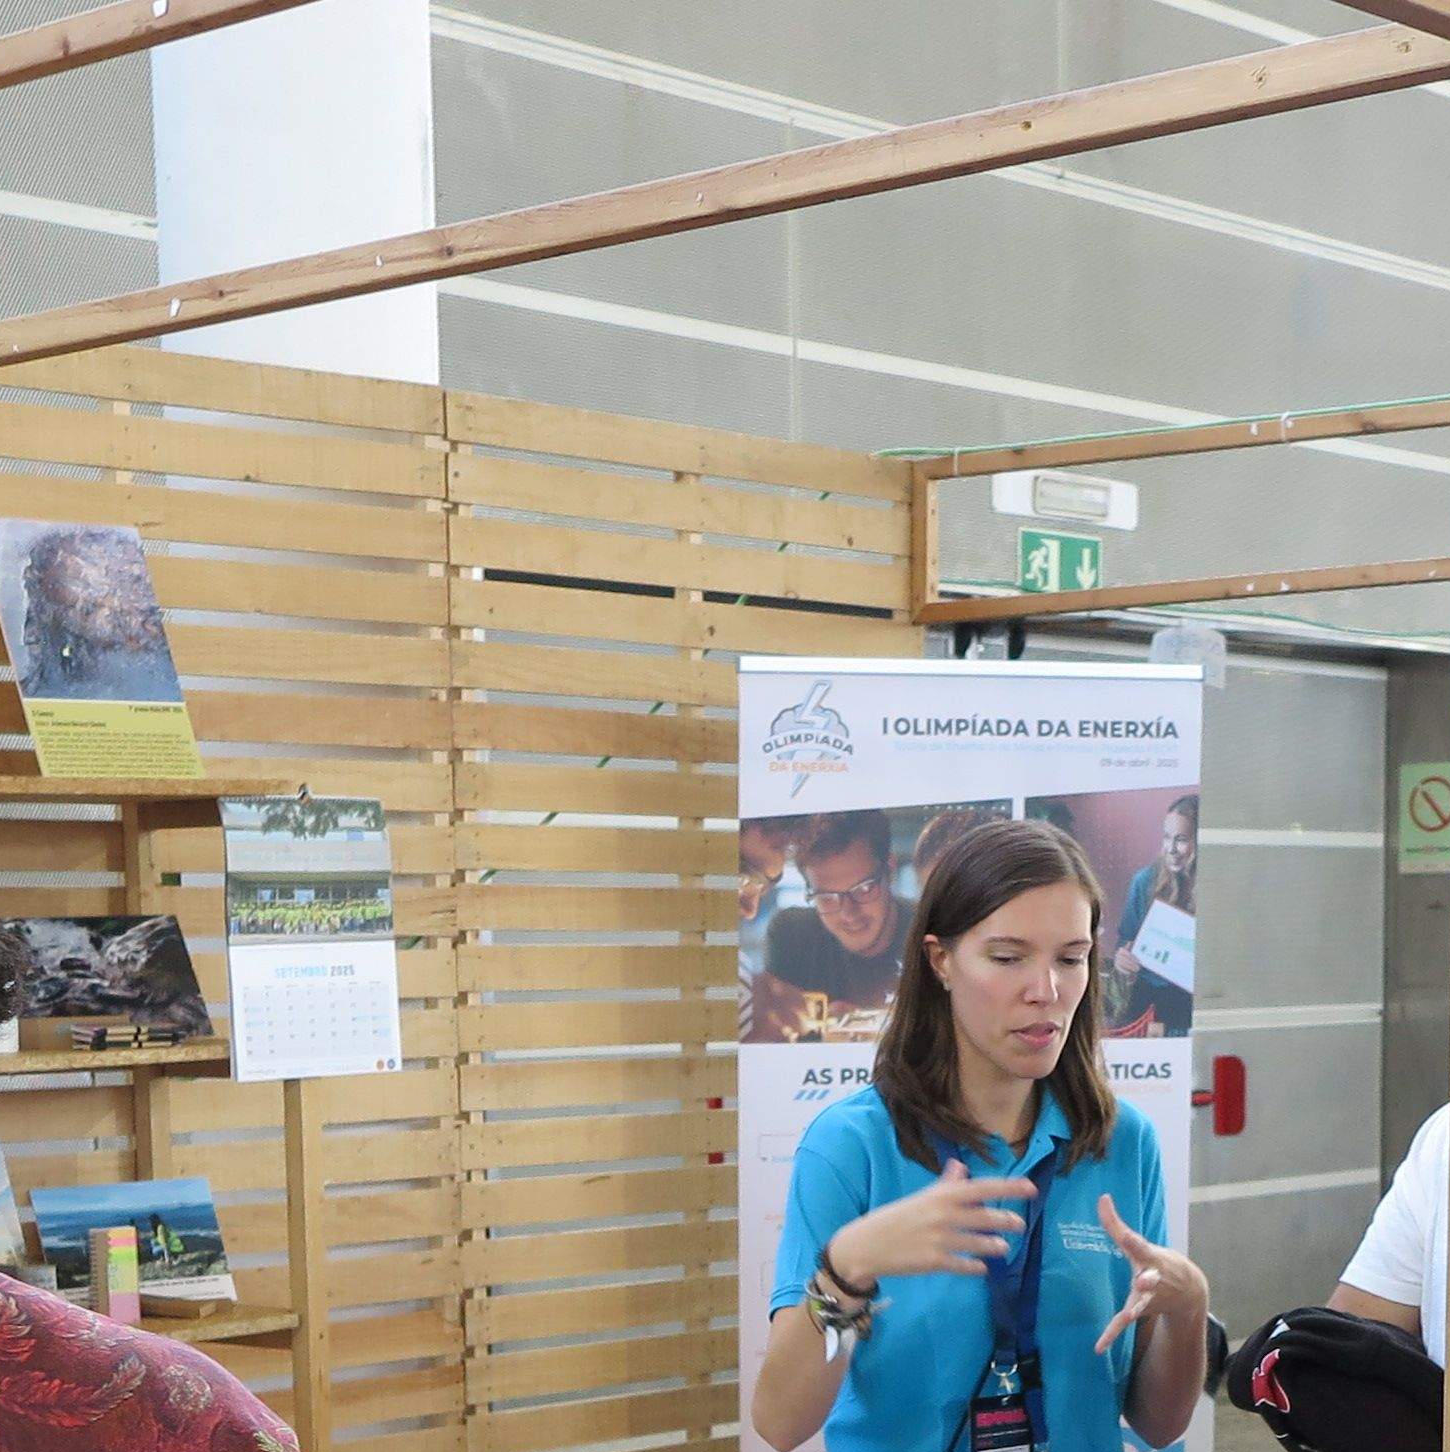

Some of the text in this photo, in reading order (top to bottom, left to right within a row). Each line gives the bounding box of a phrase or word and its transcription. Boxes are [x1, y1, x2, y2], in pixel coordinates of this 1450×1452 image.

[882, 714, 1179, 739] I OLIMPÍADA DA ENERXÍA
[802, 1068, 871, 1085] AS PR
[1108, 1062, 1172, 1079] TICAS
